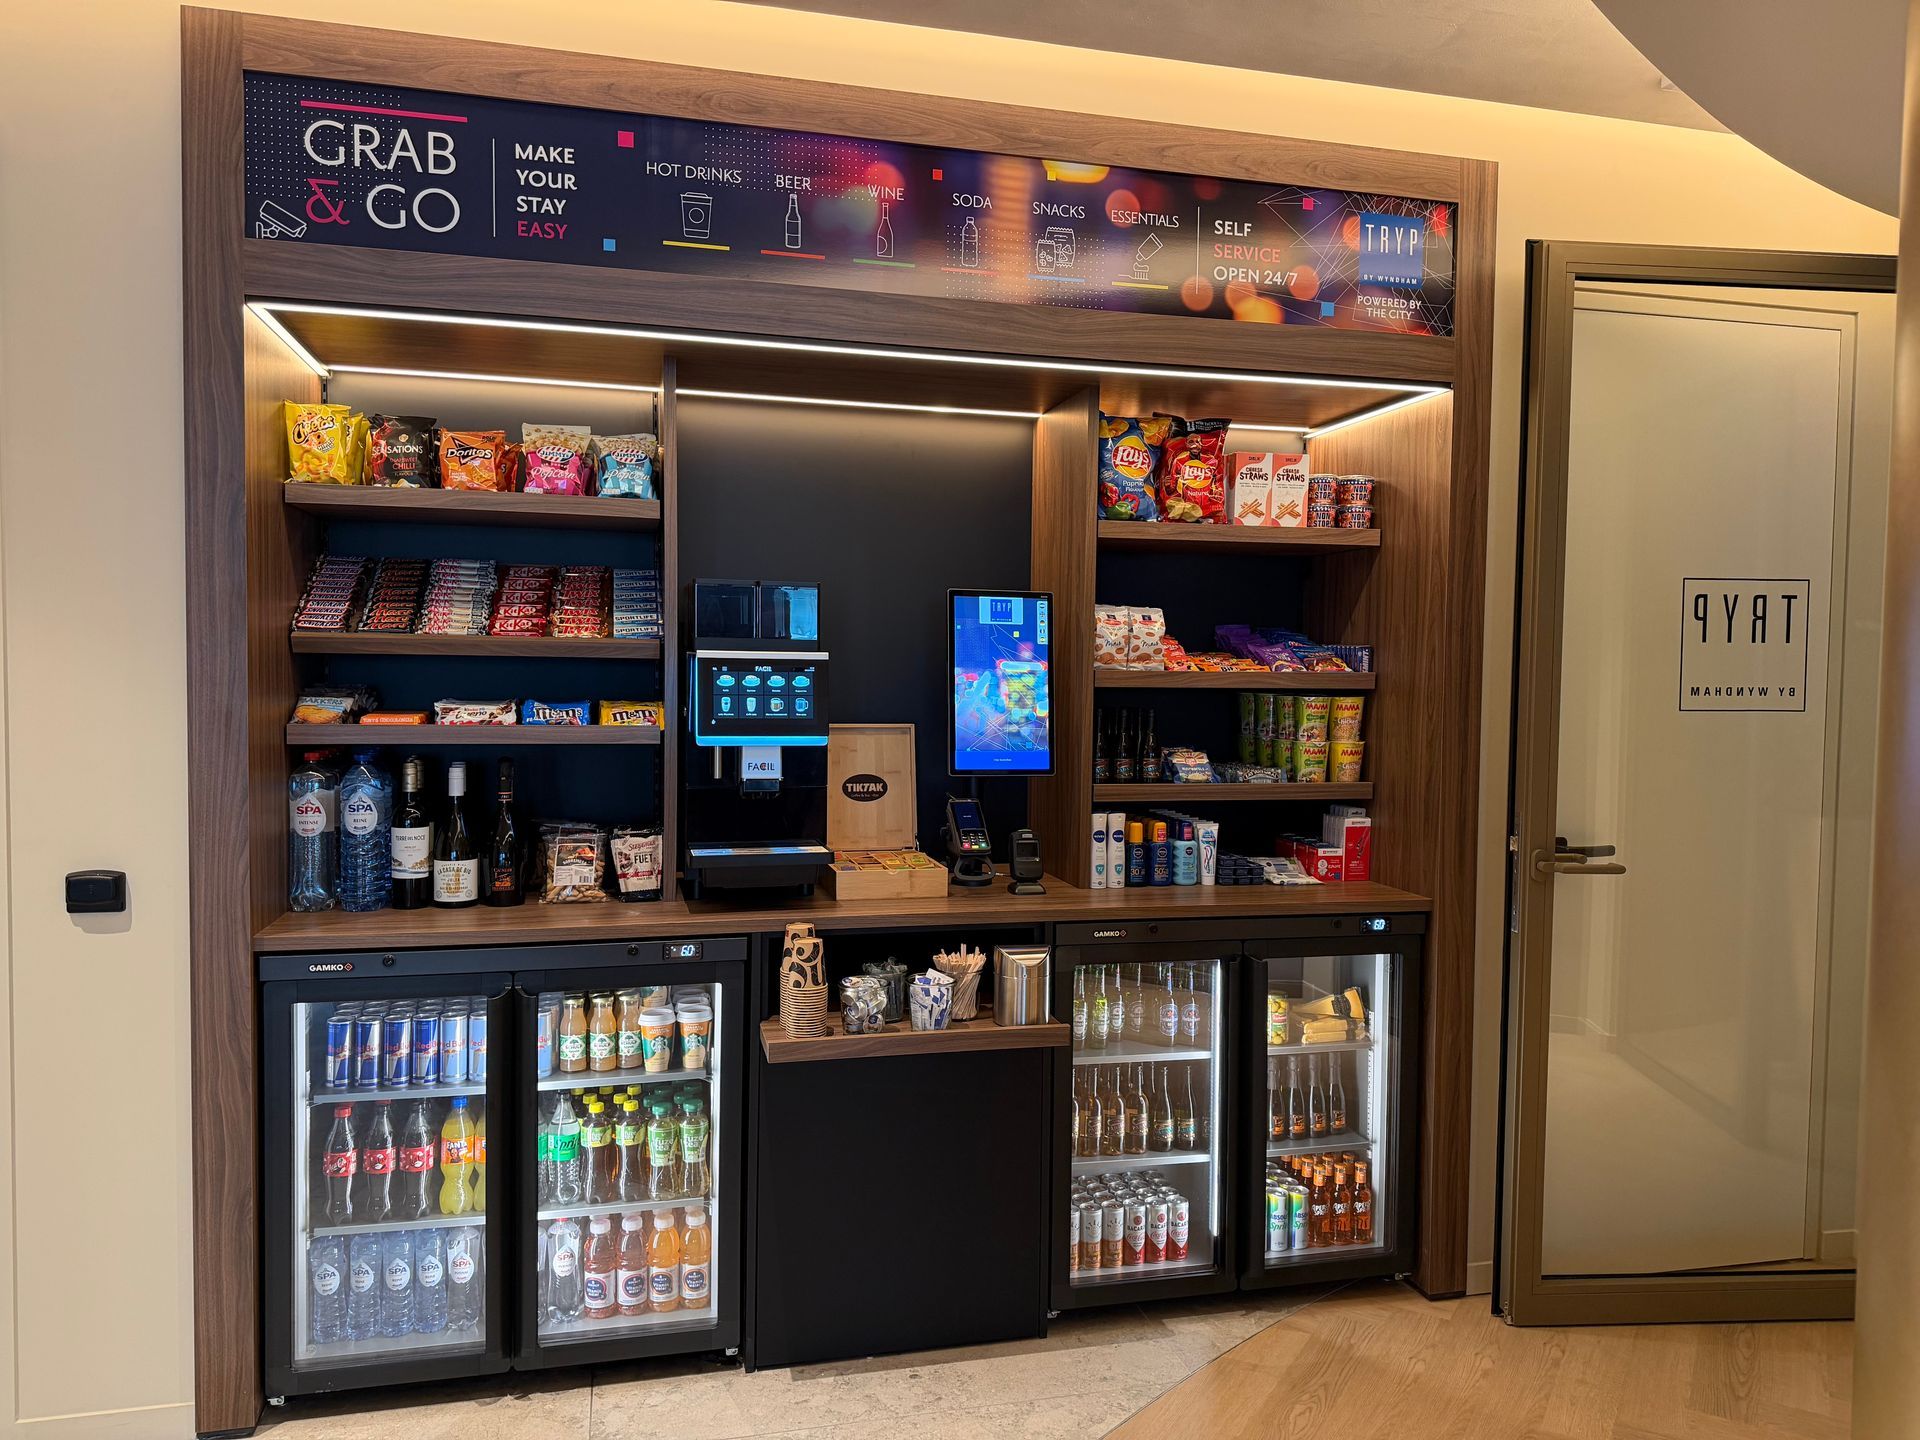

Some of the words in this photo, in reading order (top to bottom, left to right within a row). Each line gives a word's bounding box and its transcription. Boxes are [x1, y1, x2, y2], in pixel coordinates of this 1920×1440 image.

[304, 119, 457, 175] GRAB
[515, 143, 575, 164] MAKE
[646, 161, 682, 178] HOT
[686, 164, 742, 184] DRINKS
[516, 168, 577, 191] YOUR
[775, 174, 811, 191] BEER
[868, 184, 905, 201] WINE
[305, 178, 350, 224] &
[366, 184, 460, 232] GO
[516, 195, 566, 216] STAY
[952, 193, 992, 210] SODA
[1033, 202, 1085, 219] SNACKS
[1111, 210, 1180, 228] ESSENTIALS
[517, 220, 567, 240] EASY
[1214, 220, 1252, 237] SELF
[1365, 224, 1418, 256] TRYP
[1214, 243, 1281, 263] SERVICE
[1214, 266, 1260, 284] OPEN
[1263, 269, 1298, 287] 24/7
[1378, 275, 1418, 285] WYNDHAM
[1357, 295, 1407, 309] POWERED
[1409, 299, 1422, 310] BY
[1366, 307, 1387, 318] THE
[372, 445, 423, 456] SENSATIONS
[446, 448, 493, 459] Doritos
[392, 462, 415, 470] CHILLI
[1239, 471, 1268, 482] STRAWS
[1276, 473, 1305, 483] STRAWS
[1304, 748, 1327, 756] MAMA
[747, 762, 775, 771] FACIL
[846, 783, 883, 792] TIKTAK
[296, 806, 322, 815] SPA
[348, 804, 373, 813] SPA
[634, 854, 653, 864] FUET
[309, 964, 344, 972] GAMKO
[352, 1268, 370, 1277] SPA
[388, 1266, 407, 1275] SPA
[420, 1263, 439, 1273] SPA
[317, 1271, 337, 1280] SPA
